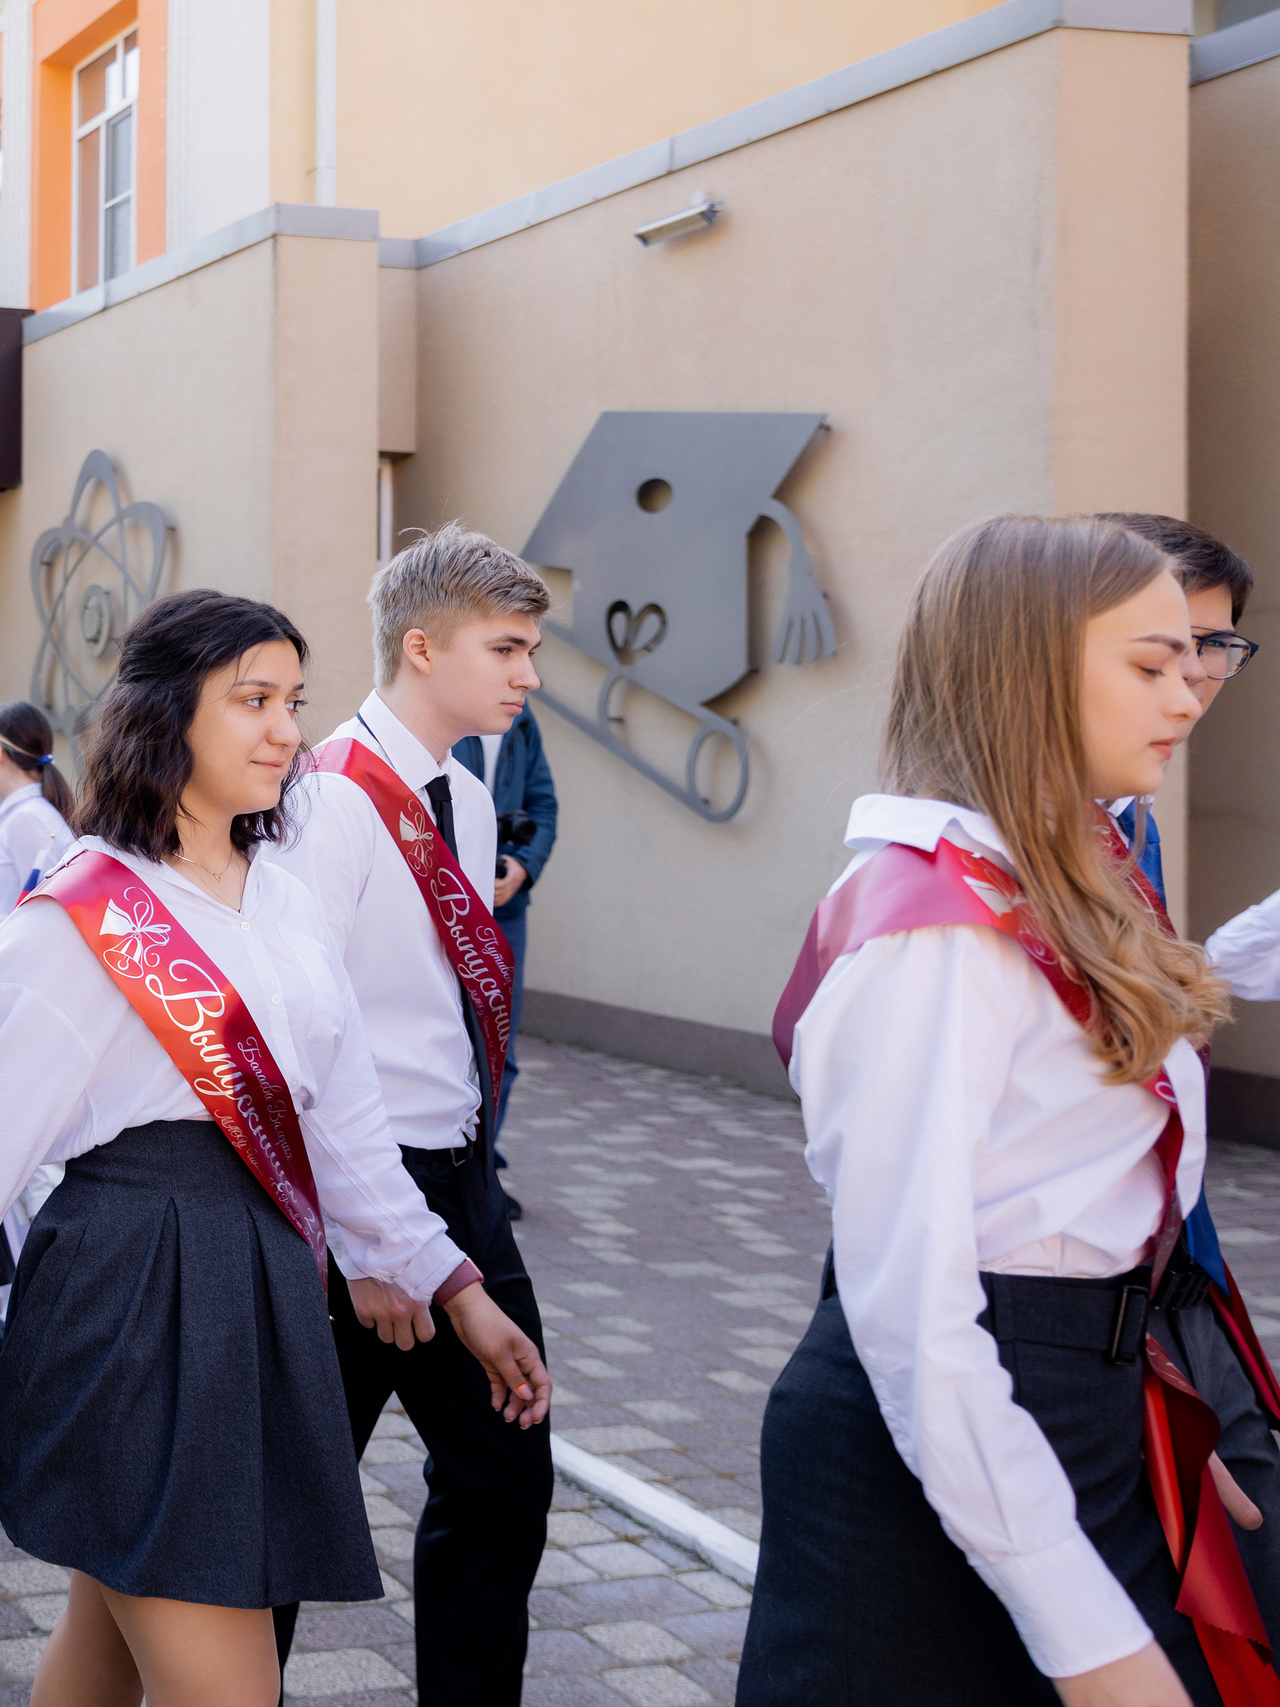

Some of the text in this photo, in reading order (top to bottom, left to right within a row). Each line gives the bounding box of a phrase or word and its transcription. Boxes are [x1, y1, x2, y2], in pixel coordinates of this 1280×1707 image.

[430, 867, 511, 1053] Выпускник
[145, 958, 298, 1204] Выпускница
[214, 1108, 248, 1151] МАОУ
[237, 1036, 293, 1162] Багаева Валерия
